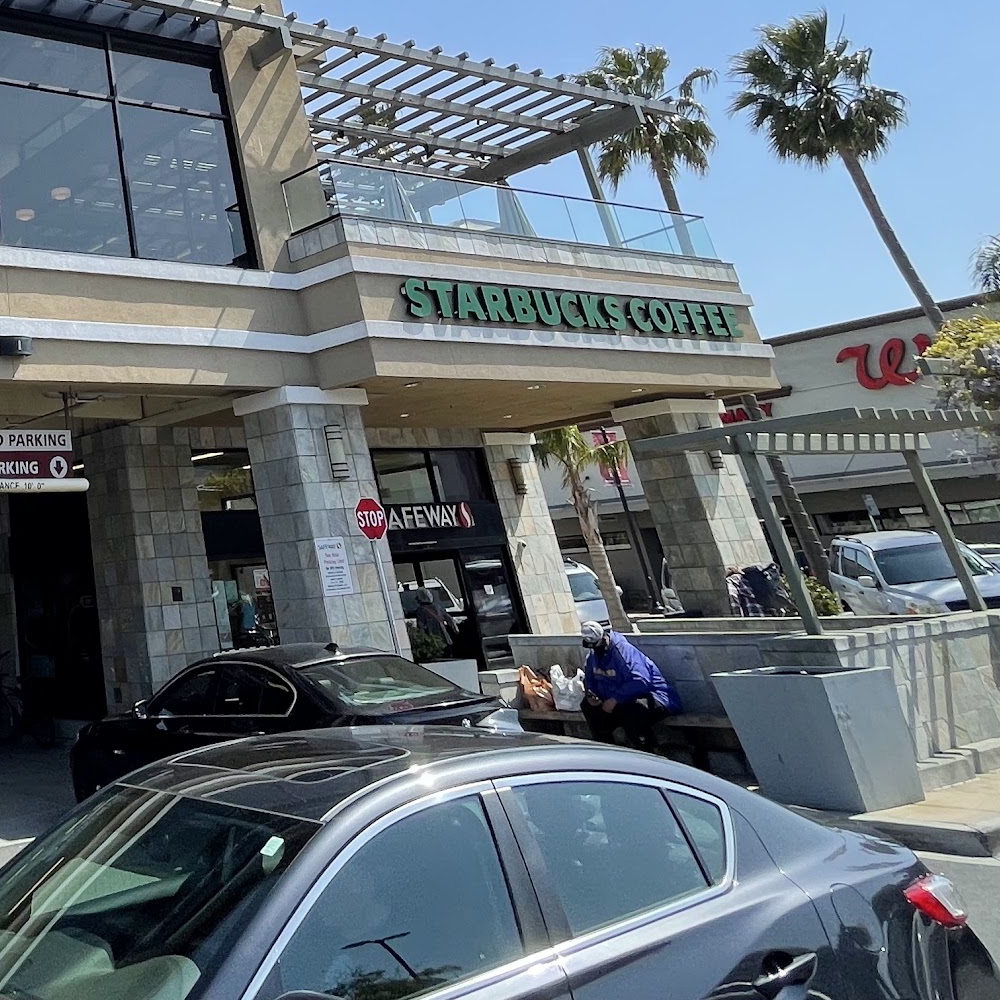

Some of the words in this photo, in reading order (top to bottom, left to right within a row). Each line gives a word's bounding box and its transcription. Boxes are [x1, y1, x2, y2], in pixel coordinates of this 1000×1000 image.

[401, 278, 627, 331] STARBUCKS
[629, 297, 744, 337] COFFEE
[8, 433, 67, 447] PARKING
[357, 510, 384, 528] STOP
[389, 505, 457, 530] AFEWAY
